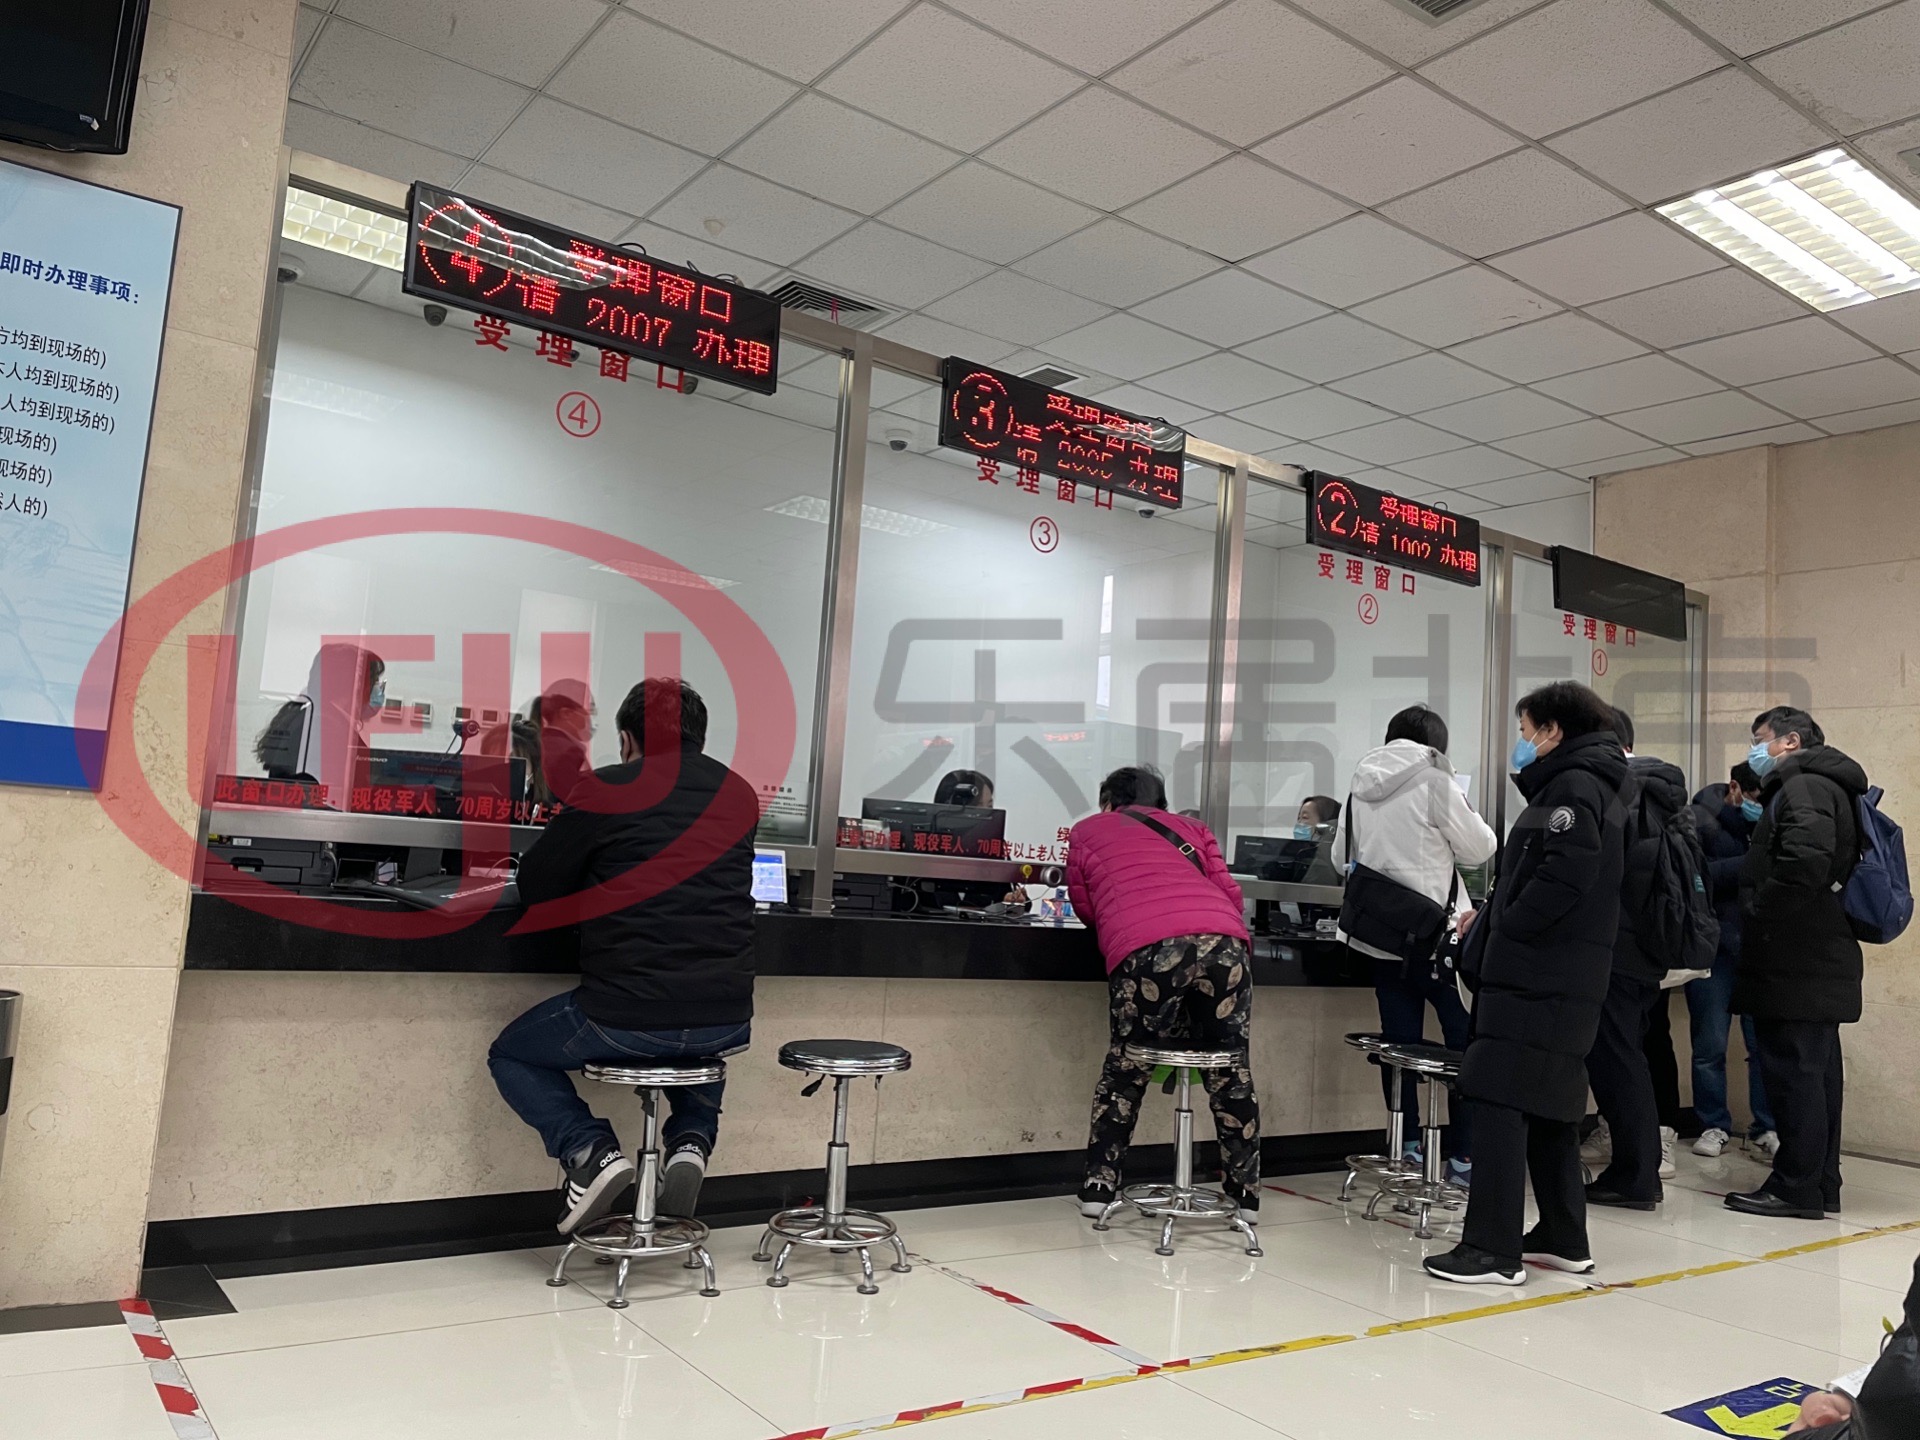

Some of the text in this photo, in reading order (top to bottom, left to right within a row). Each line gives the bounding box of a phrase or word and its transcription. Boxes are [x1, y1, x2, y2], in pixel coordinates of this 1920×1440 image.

[0, 252, 139, 304] 即时办理事项：
[566, 239, 733, 324] 受理窗口
[474, 314, 684, 394] 受理窗口
[585, 297, 673, 347] 2007
[692, 327, 772, 375] 办理
[976, 457, 1114, 510] 受理窗口
[1317, 552, 1416, 596] 受理窗口
[1439, 543, 1478, 573] 办理
[1562, 613, 1636, 648] 受理窗口
